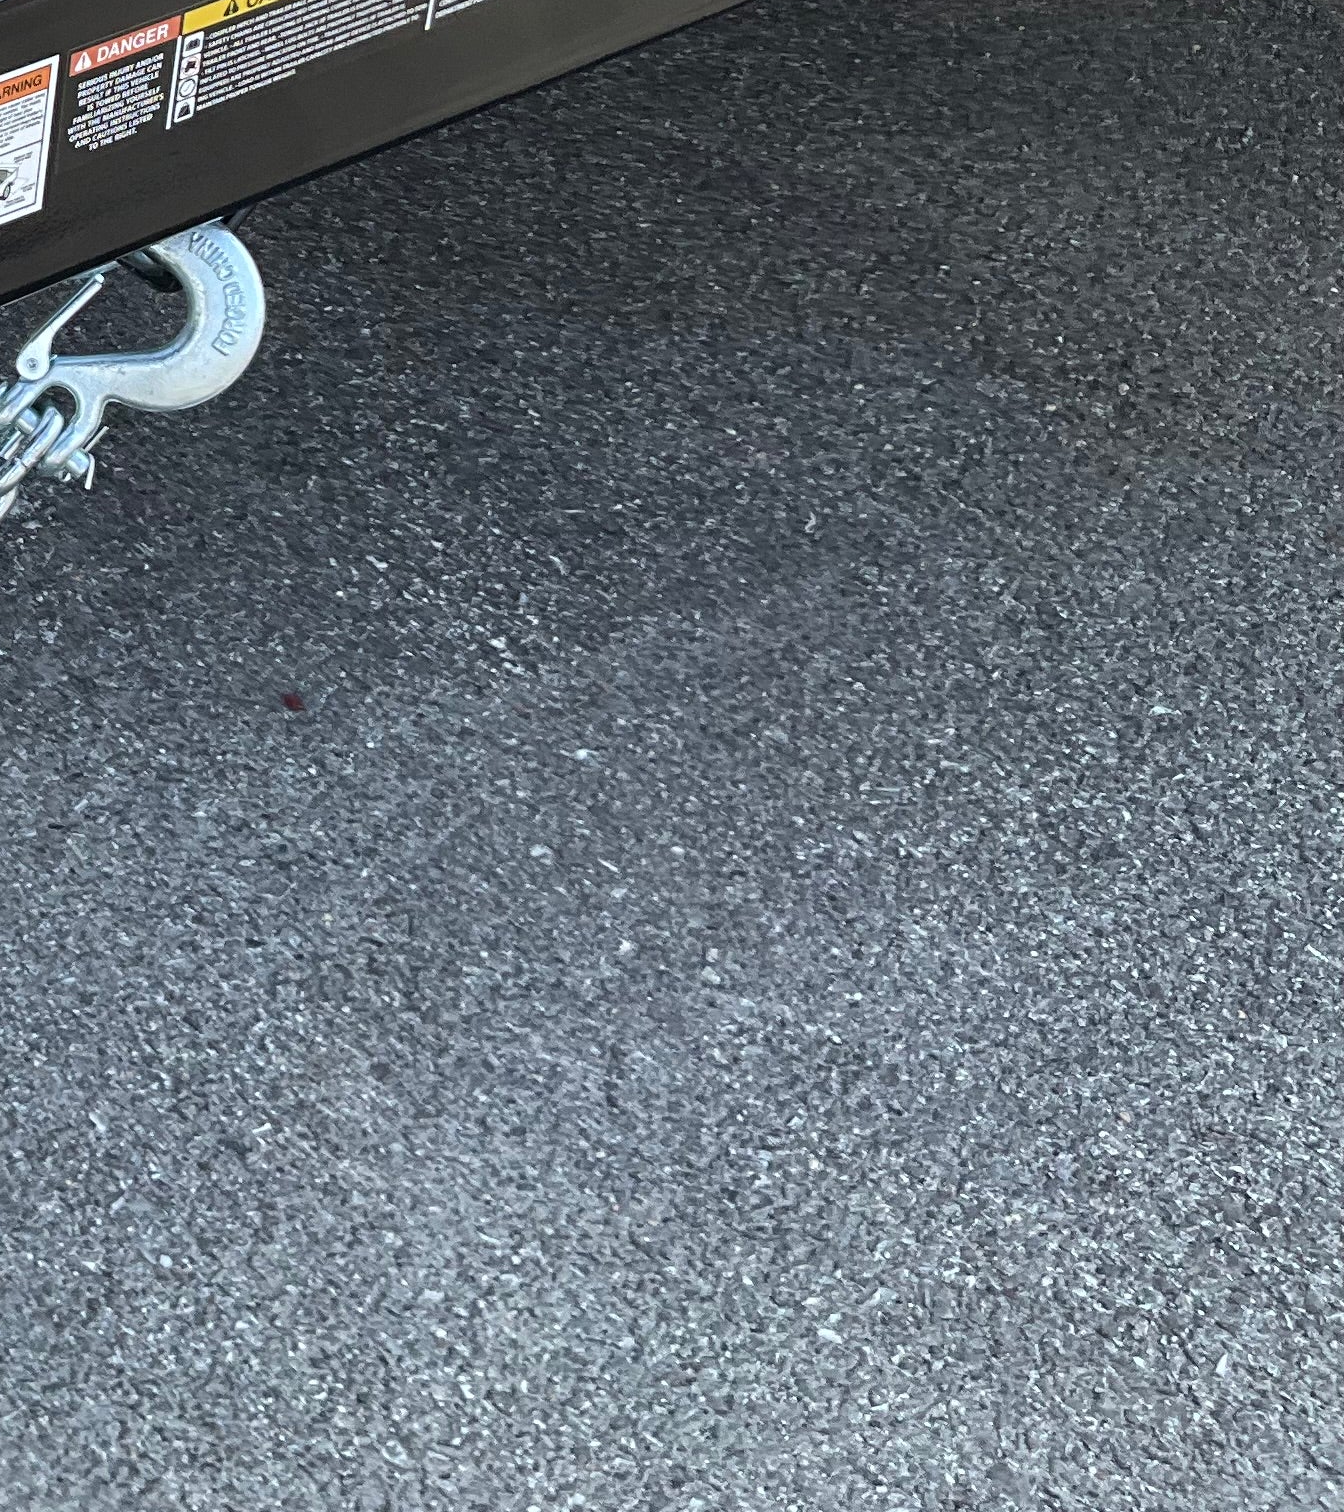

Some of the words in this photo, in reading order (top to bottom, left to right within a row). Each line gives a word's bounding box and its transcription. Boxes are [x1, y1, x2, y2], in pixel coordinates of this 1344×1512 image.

[97, 23, 168, 62] DANGER
[185, 230, 238, 282] CHINA
[211, 280, 248, 357] FORGED
